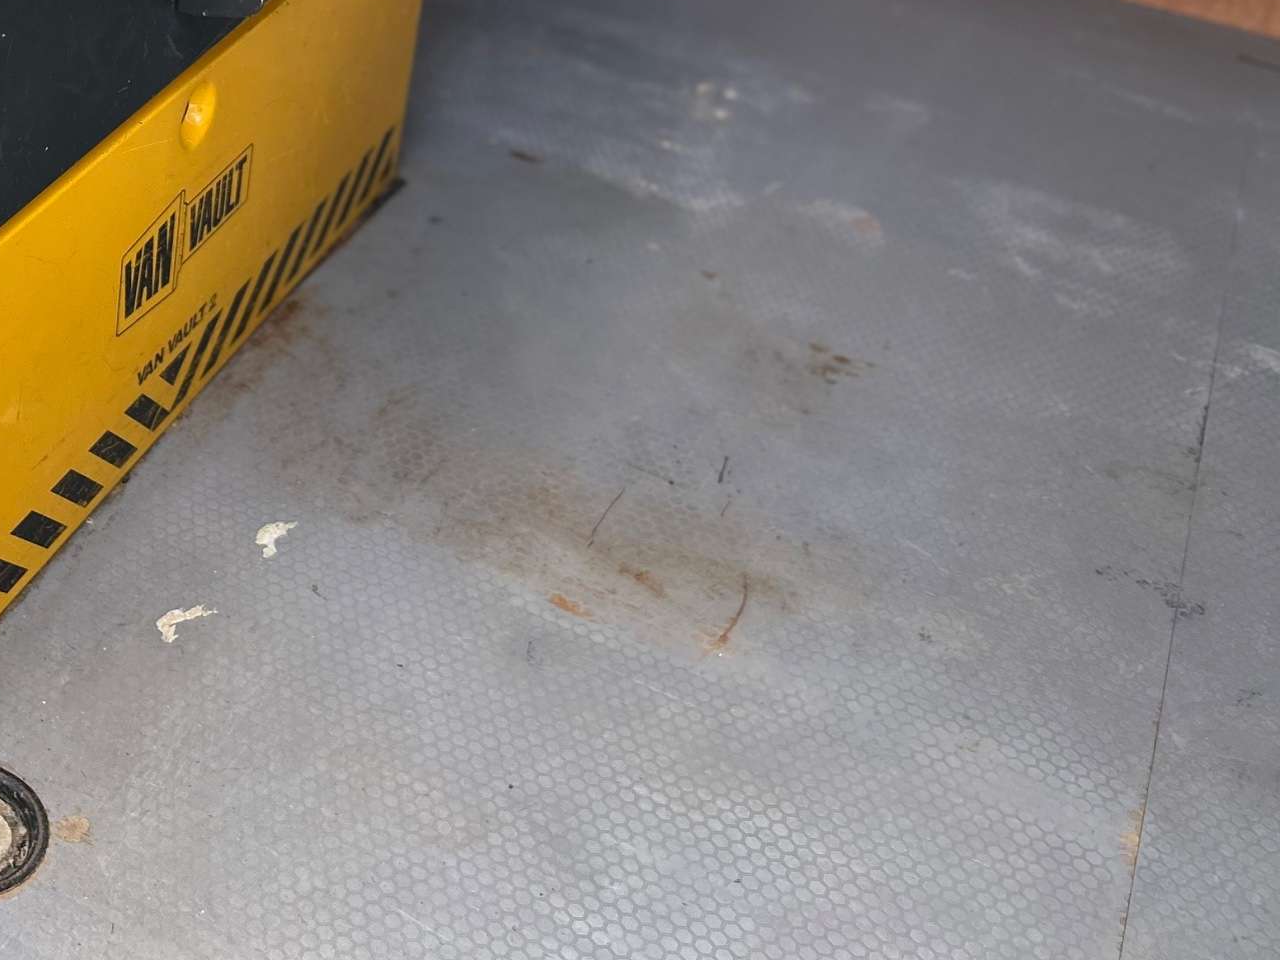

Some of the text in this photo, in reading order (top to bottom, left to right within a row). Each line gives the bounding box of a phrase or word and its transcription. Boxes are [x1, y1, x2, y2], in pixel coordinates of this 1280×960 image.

[125, 154, 247, 320] VAN VAULT
[138, 293, 217, 386] VAN VAULT 2
